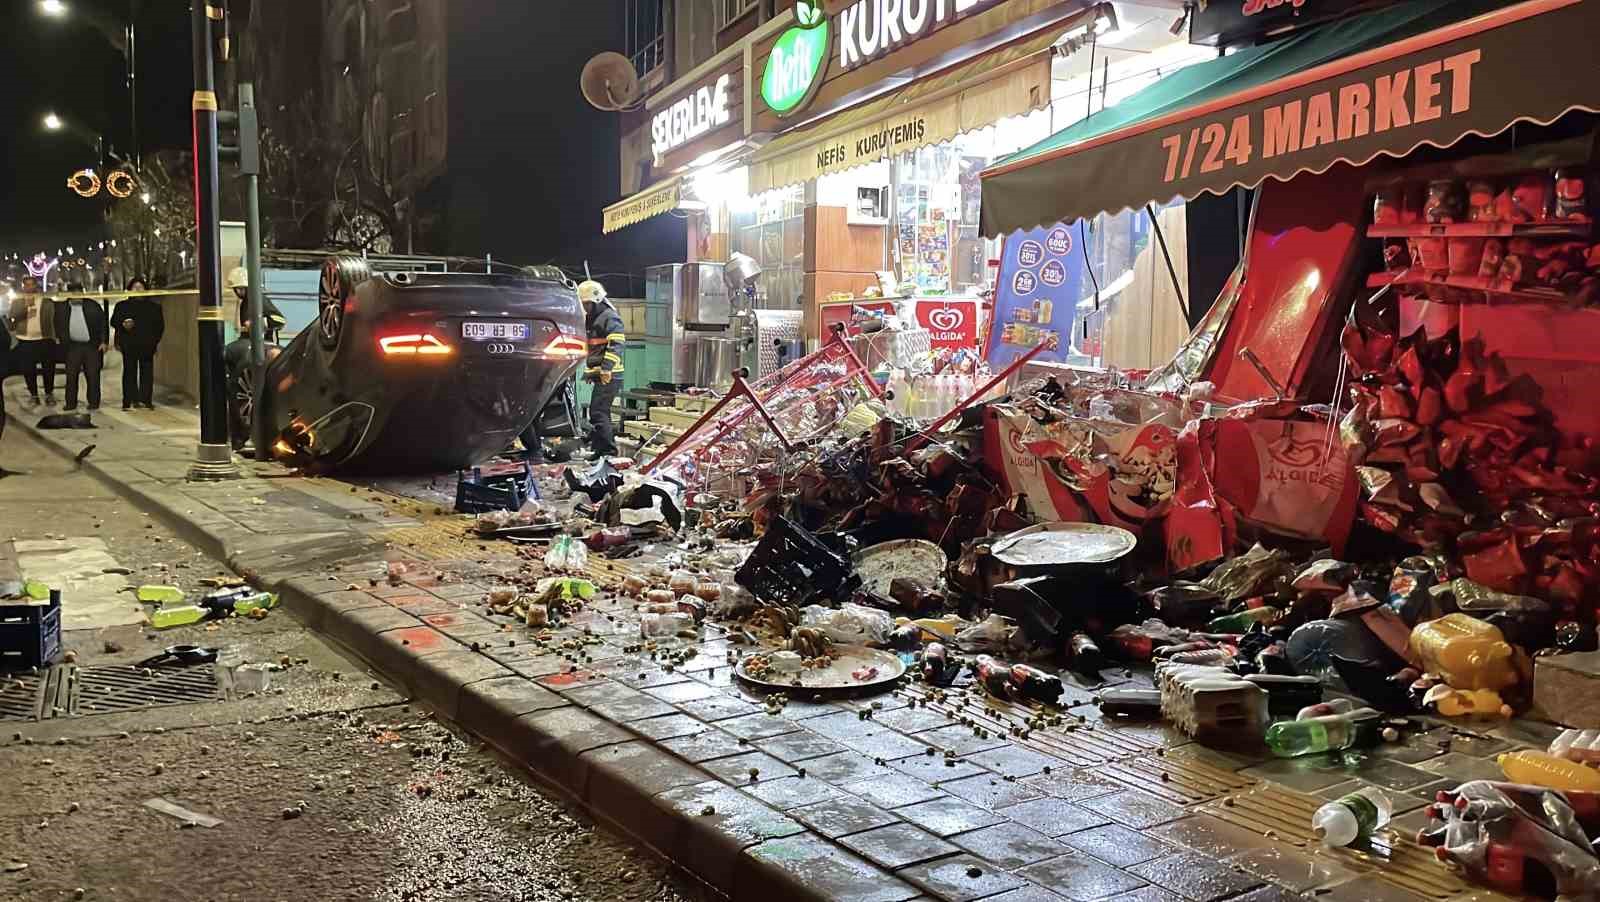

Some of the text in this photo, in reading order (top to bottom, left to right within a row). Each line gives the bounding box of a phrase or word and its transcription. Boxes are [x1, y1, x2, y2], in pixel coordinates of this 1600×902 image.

[652, 74, 729, 167] ŞEKERLEME
[817, 116, 925, 168] NEFİS KURUYEMİŞ
[1162, 49, 1481, 182] 7/24 MARKET
[465, 324, 524, 336] 58 ER 603
